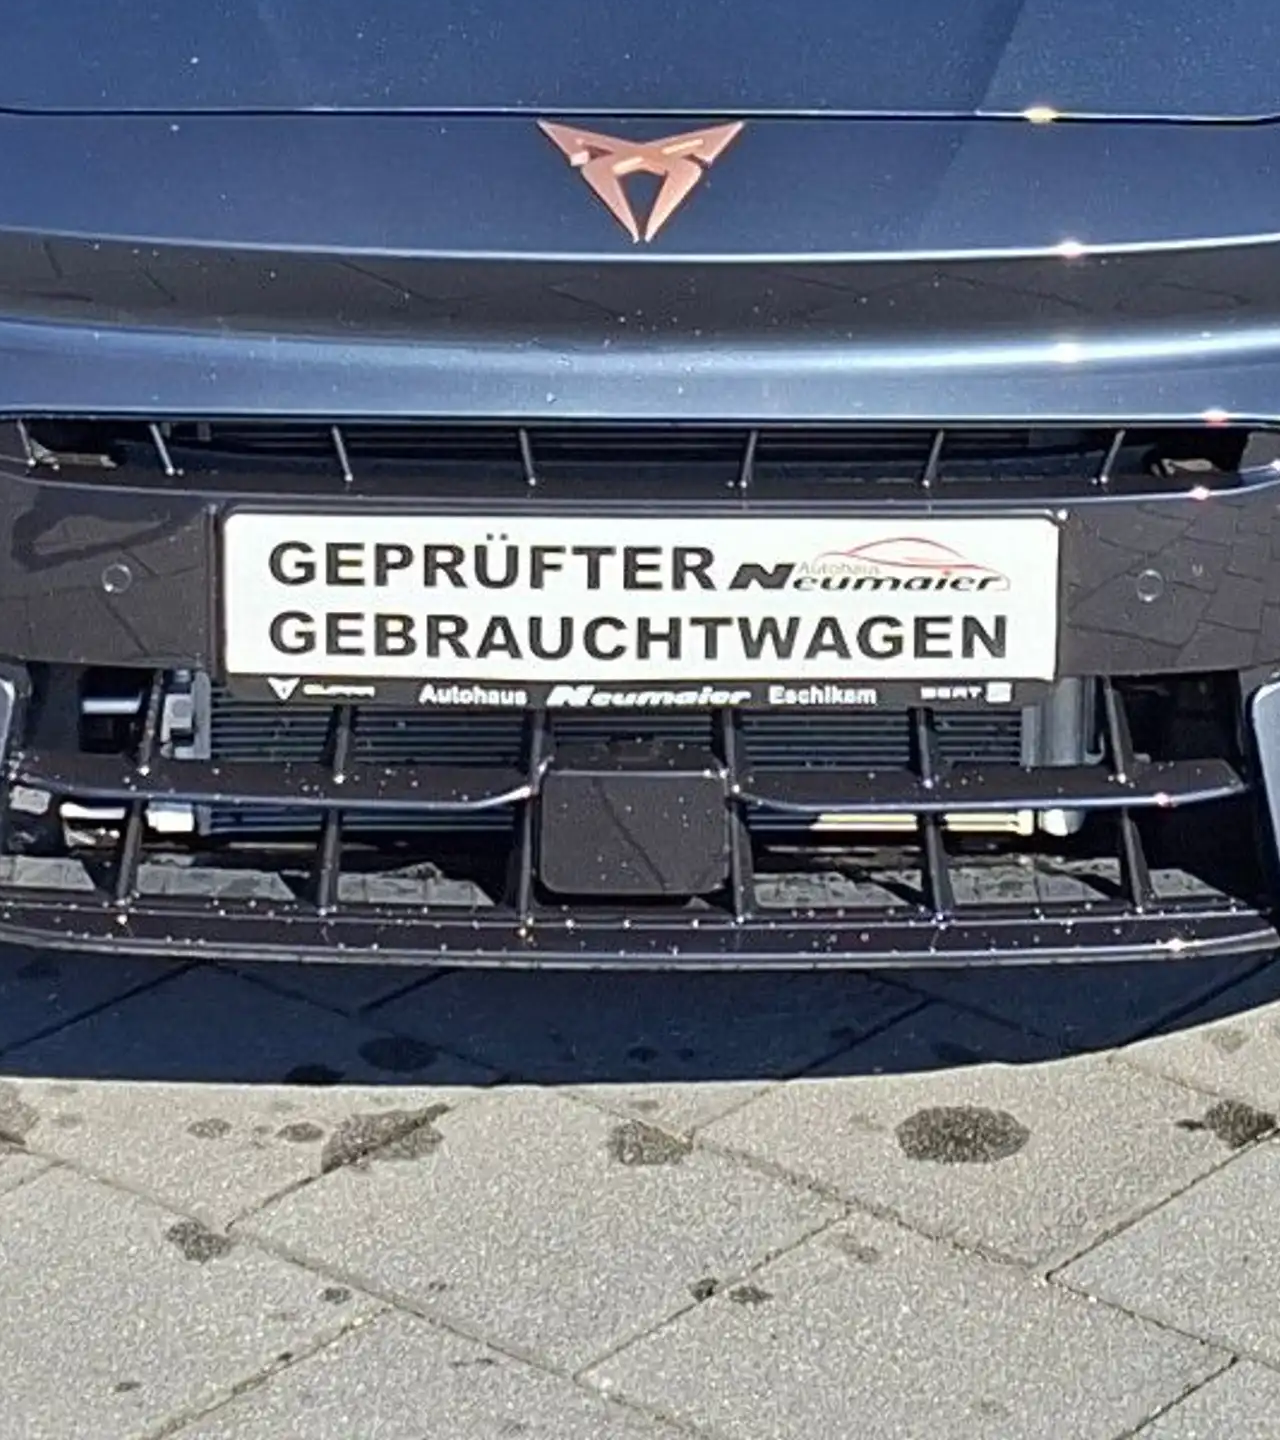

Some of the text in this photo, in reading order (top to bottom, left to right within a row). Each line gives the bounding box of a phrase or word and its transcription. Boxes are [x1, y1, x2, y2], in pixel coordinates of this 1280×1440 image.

[269, 534, 716, 591] GEPRÜFTER
[728, 562, 1003, 591] Neumaier
[269, 611, 1006, 661] GEBRAUCHTWAGEN
[420, 684, 528, 706] Autohaus
[546, 684, 751, 707] Neumaier
